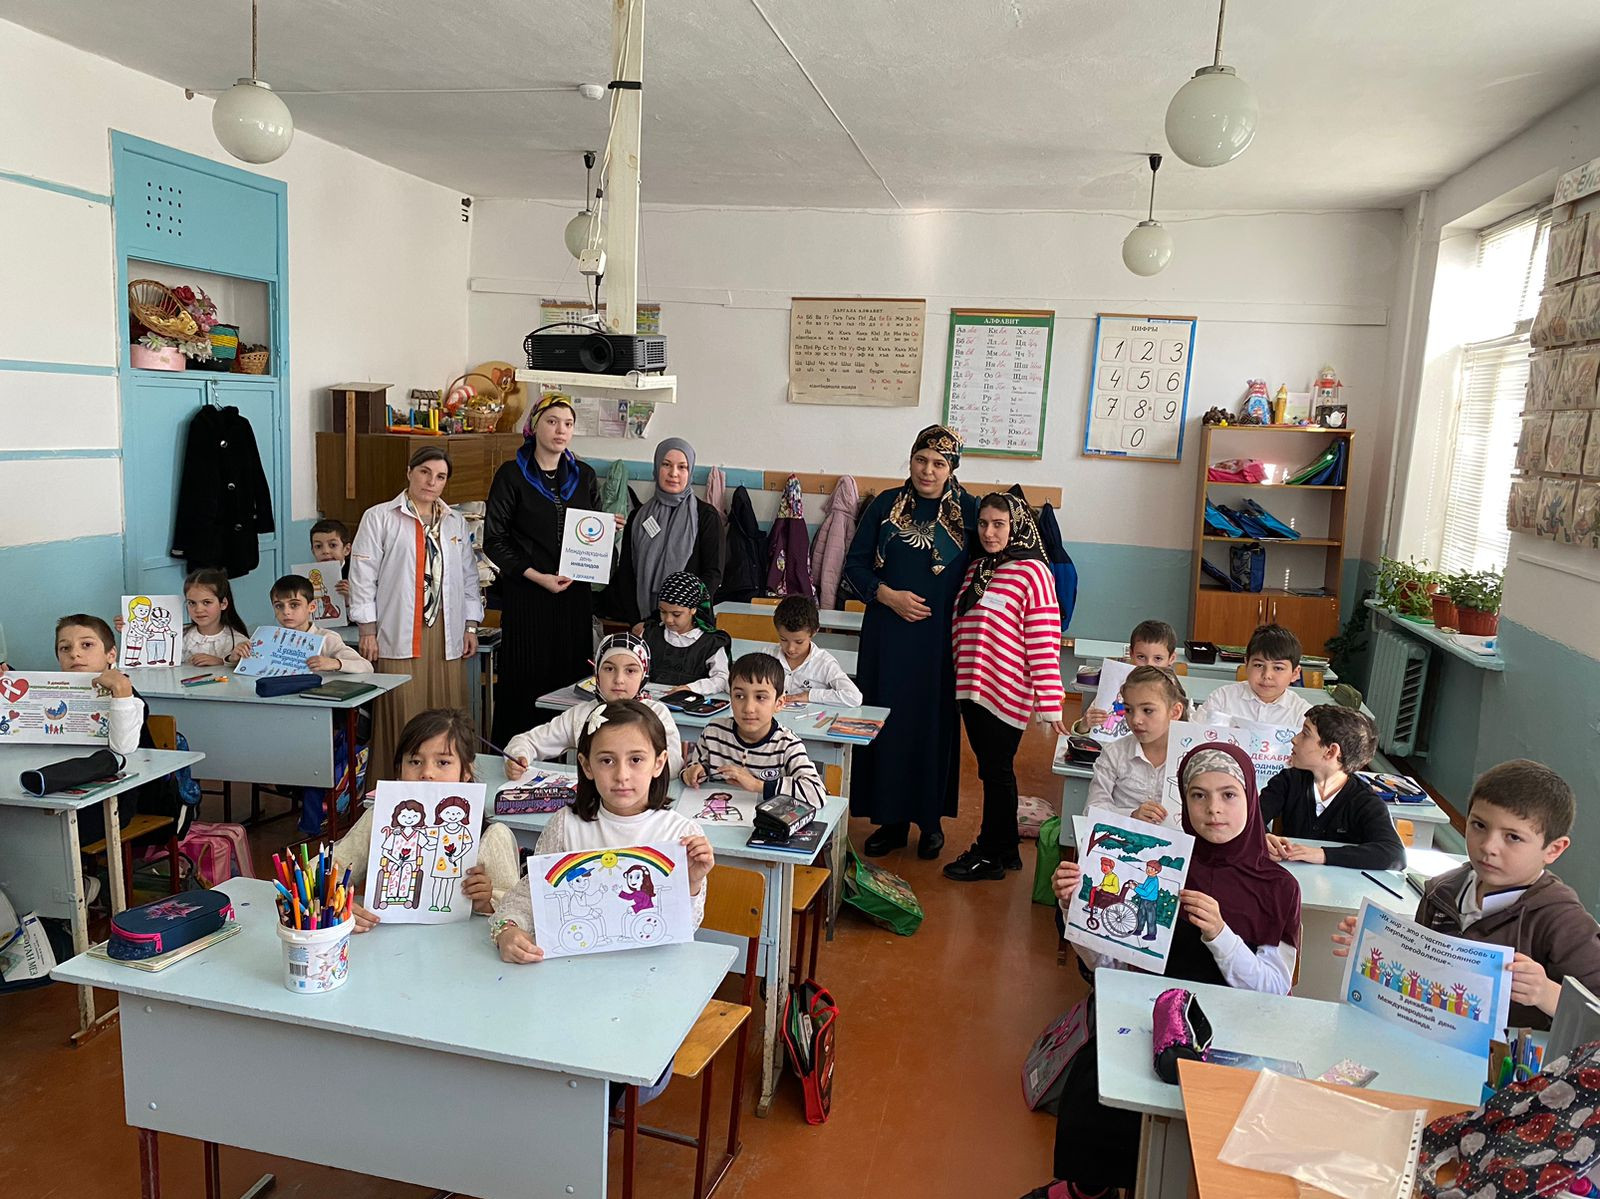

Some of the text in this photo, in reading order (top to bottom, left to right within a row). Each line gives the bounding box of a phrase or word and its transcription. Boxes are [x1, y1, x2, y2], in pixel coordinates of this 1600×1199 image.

[1114, 340, 1183, 362] 1 2 3
[1110, 369, 1180, 391] 4 5 6
[1107, 398, 1176, 420] 7 8 9
[1130, 428, 1144, 447] 0
[565, 547, 608, 558] Международный
[1260, 741, 1270, 752] 3
[1251, 753, 1291, 762] ДЕКАБР
[1389, 918, 1402, 929] мир
[1406, 927, 1420, 938] это
[1420, 934, 1454, 950] счастье,
[1456, 945, 1488, 959] любовь
[1430, 947, 1481, 965] постоянное
[1377, 993, 1457, 1030] Международный день
[1404, 997, 1434, 1013] декабря
